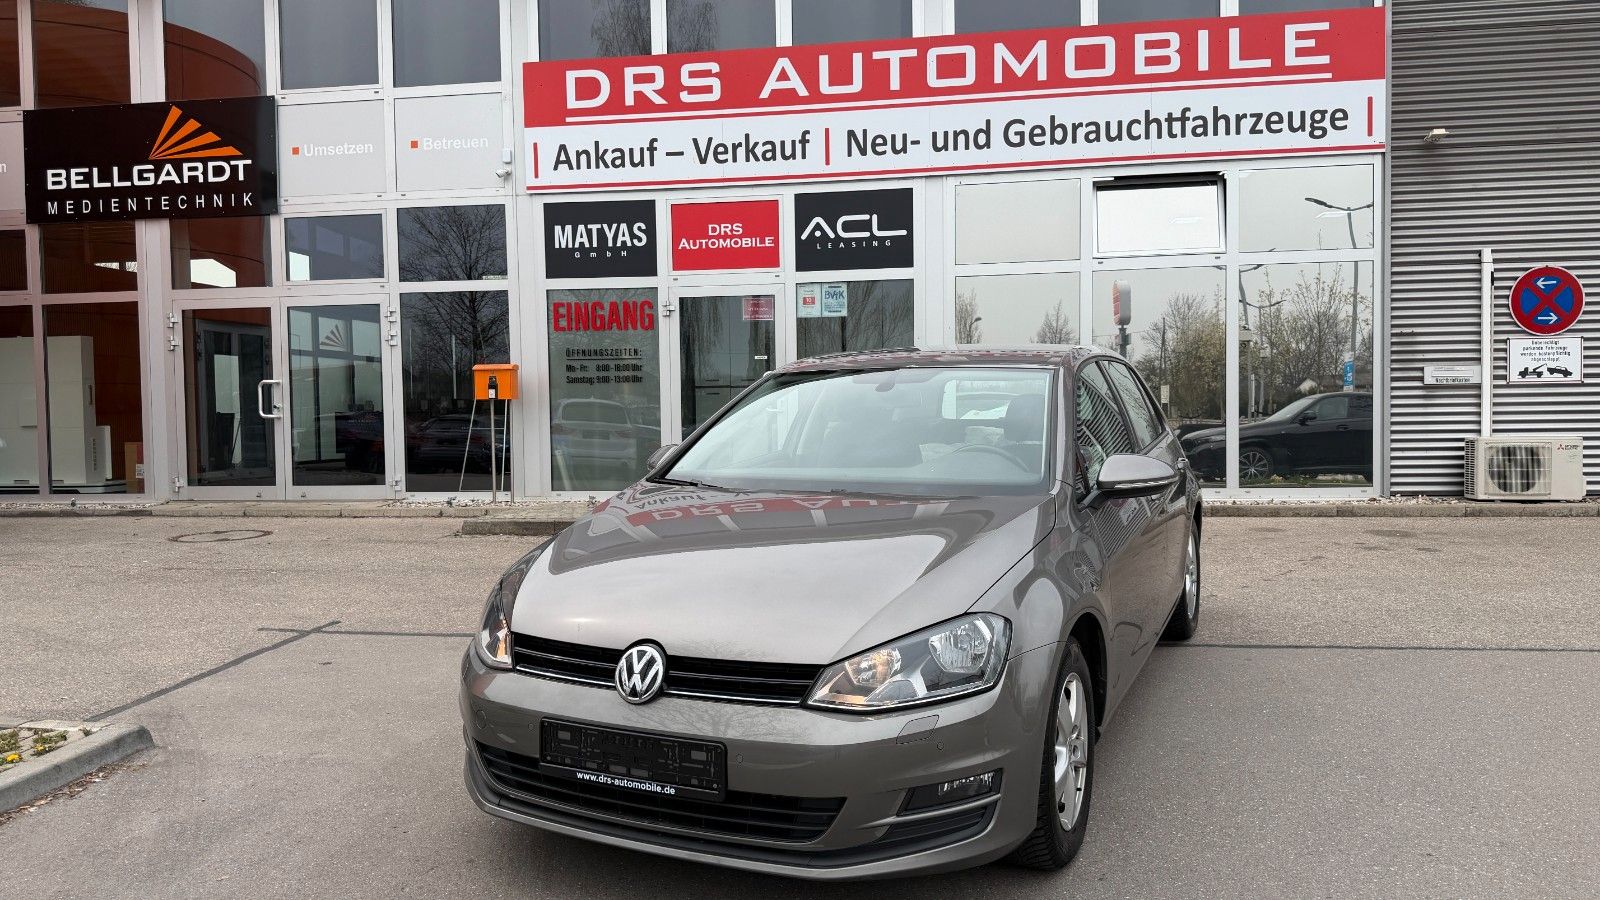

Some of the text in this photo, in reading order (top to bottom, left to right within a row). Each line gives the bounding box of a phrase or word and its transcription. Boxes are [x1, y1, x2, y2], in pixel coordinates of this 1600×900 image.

[565, 22, 1330, 110] DRS AUTOMOBILE
[423, 135, 489, 151] Betreuen
[553, 138, 658, 171] Ankauf
[692, 130, 811, 165] Verkauf
[846, 128, 921, 158] Neu-
[931, 119, 991, 153] und
[1003, 106, 1349, 148] Gebrauchtfahrzeuge
[304, 141, 374, 157] Umsetzen
[46, 160, 252, 190] BELLGARDT
[47, 192, 254, 215] MEDIENTECHNIK
[554, 222, 647, 249] MATYAS
[708, 223, 743, 236] DRS
[801, 213, 908, 241] ACL
[678, 236, 775, 250] AUTOMOBILE
[816, 240, 892, 250] LEASING
[552, 300, 656, 332] EINGANG
[565, 347, 642, 358] ÖFFNUNGSZEITEN:
[631, 363, 642, 371] Uhr
[631, 375, 643, 383] Uhr
[576, 771, 676, 795] www.drs-automobile.de
